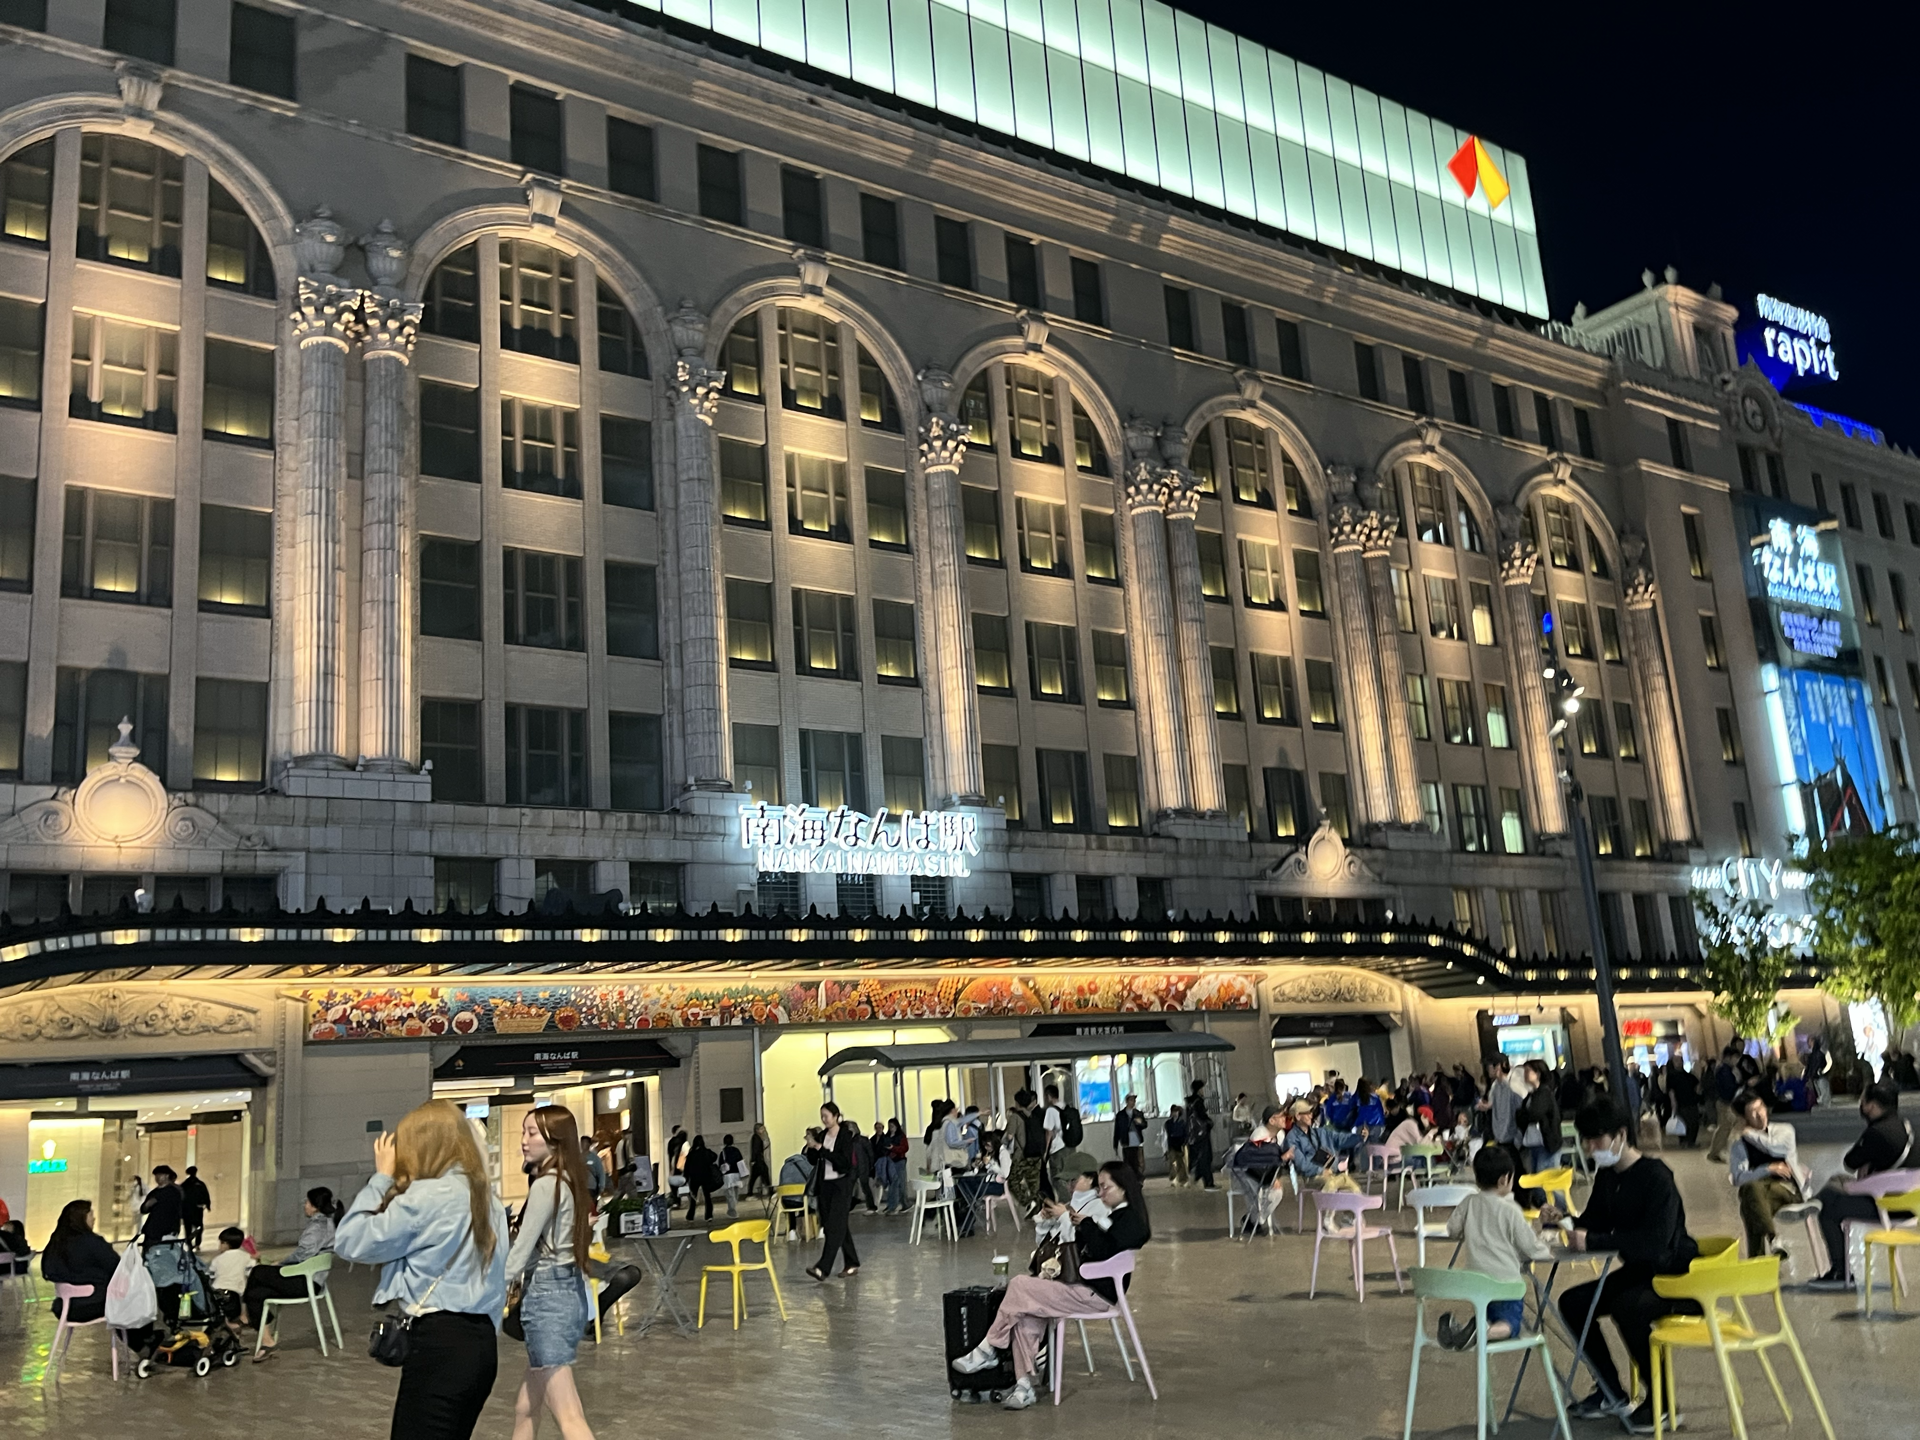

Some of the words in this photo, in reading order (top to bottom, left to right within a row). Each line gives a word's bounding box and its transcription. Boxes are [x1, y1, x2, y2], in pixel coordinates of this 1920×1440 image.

[739, 800, 981, 857] 南海なんば駅
[757, 848, 843, 873] NANKAI
[846, 851, 923, 876] NAMBA
[1722, 857, 1782, 900] CITY
[533, 1051, 579, 1061] 南海なんば駅
